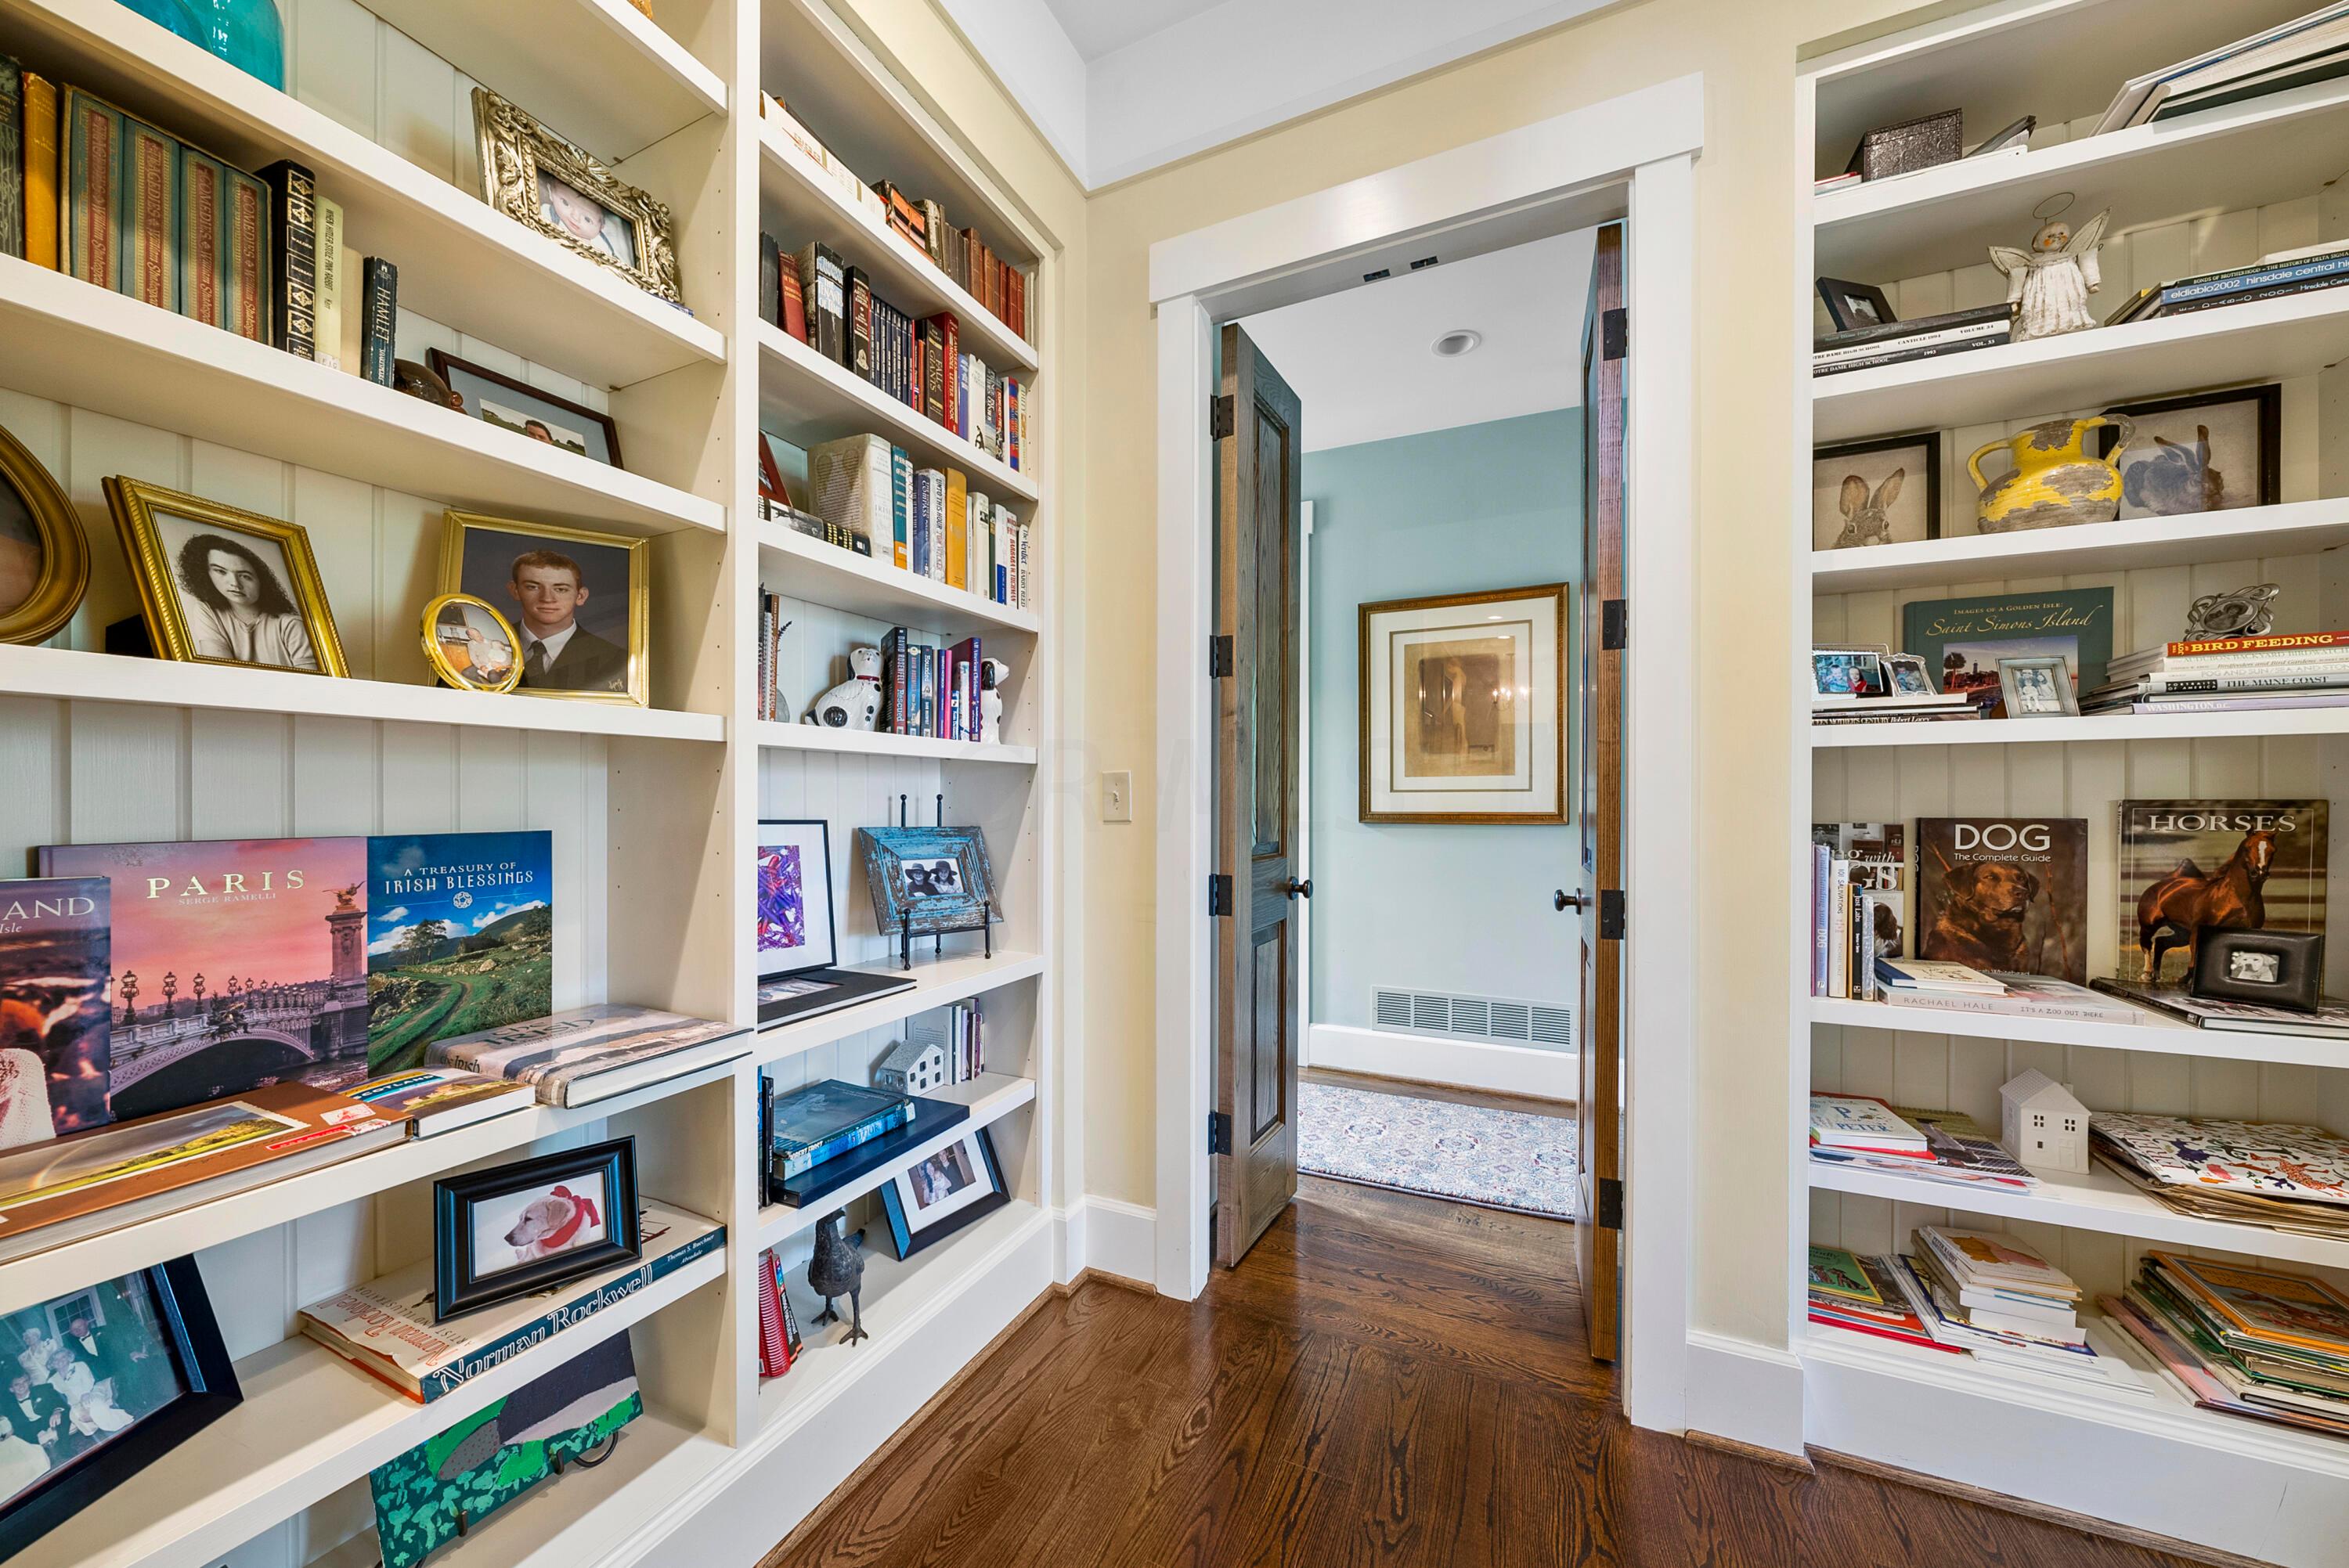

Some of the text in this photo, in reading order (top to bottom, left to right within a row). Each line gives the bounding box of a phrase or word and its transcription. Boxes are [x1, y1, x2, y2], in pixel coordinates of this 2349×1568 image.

[146, 149, 161, 218] TRAGEDIES
[199, 174, 212, 242] COMEDIES
[325, 208, 334, 225] WHEN
[243, 194, 256, 261] COMEDIES
[325, 224, 334, 244] HITLER
[291, 236, 313, 250] WALDEN
[325, 243, 334, 259] STOLE
[290, 265, 313, 277] THOREAU
[324, 258, 334, 272] PINK
[2193, 276, 2213, 285] BONDS
[2279, 259, 2304, 269] HISTORY
[2312, 254, 2330, 263] DELTA
[2330, 251, 2349, 260] SIGMA
[324, 272, 333, 291] RABBIT
[2170, 260, 2336, 299] eldiablo2002 hinsdale central
[2300, 280, 2329, 291] Hinsdale
[376, 287, 391, 344] HAMLET
[1898, 337, 1927, 345] CANTICLE
[1849, 360, 1864, 369] HIGH
[1865, 356, 1890, 366] SCHOOL
[2006, 603, 2040, 611] GOLDEN
[1925, 604, 2104, 636] Saint Simons Island
[2191, 640, 2239, 652] BIRD
[2242, 634, 2334, 649] FEEDING
[2184, 655, 2232, 664] AUDUBON
[2234, 651, 2286, 661] BACKYARD
[2287, 657, 2317, 665] Gardens
[2201, 665, 2321, 679] FOG AND SUN AND
[2252, 678, 2290, 687] MAINE
[2293, 676, 2329, 685] COAST
[1860, 716, 1891, 725] CENTURY
[2148, 814, 2297, 832] HORSES
[1954, 824, 2051, 852] DOG
[1864, 851, 1896, 863] with
[1972, 853, 2019, 863] Complete
[2021, 854, 2051, 863] Guide
[404, 862, 517, 877] A TREASURY OF
[146, 870, 305, 899] PARIS
[385, 871, 533, 894] IRISH BLESSINGS
[1817, 852, 1828, 908] Understanding
[179, 892, 276, 906] SERGE RAMELLI
[2, 897, 96, 921] AND
[0, 924, 22, 934] Isle
[1817, 928, 1827, 948] DOG
[1903, 997, 1956, 1008] RACHAEL
[1963, 1001, 1994, 1011] HALE
[312, 1077, 341, 1088] teNeues
[352, 1073, 435, 1100] SCOTLAND
[1837, 1122, 1892, 1132] PETER
[807, 1141, 824, 1155] FROST
[666, 1234, 716, 1263] Thomas S. Buechner
[355, 1285, 474, 1346] ARTIST ILLUSTRATOR
[316, 1292, 458, 1367] Norman Rockwell
[432, 1263, 654, 1392] Norman Rockwell
